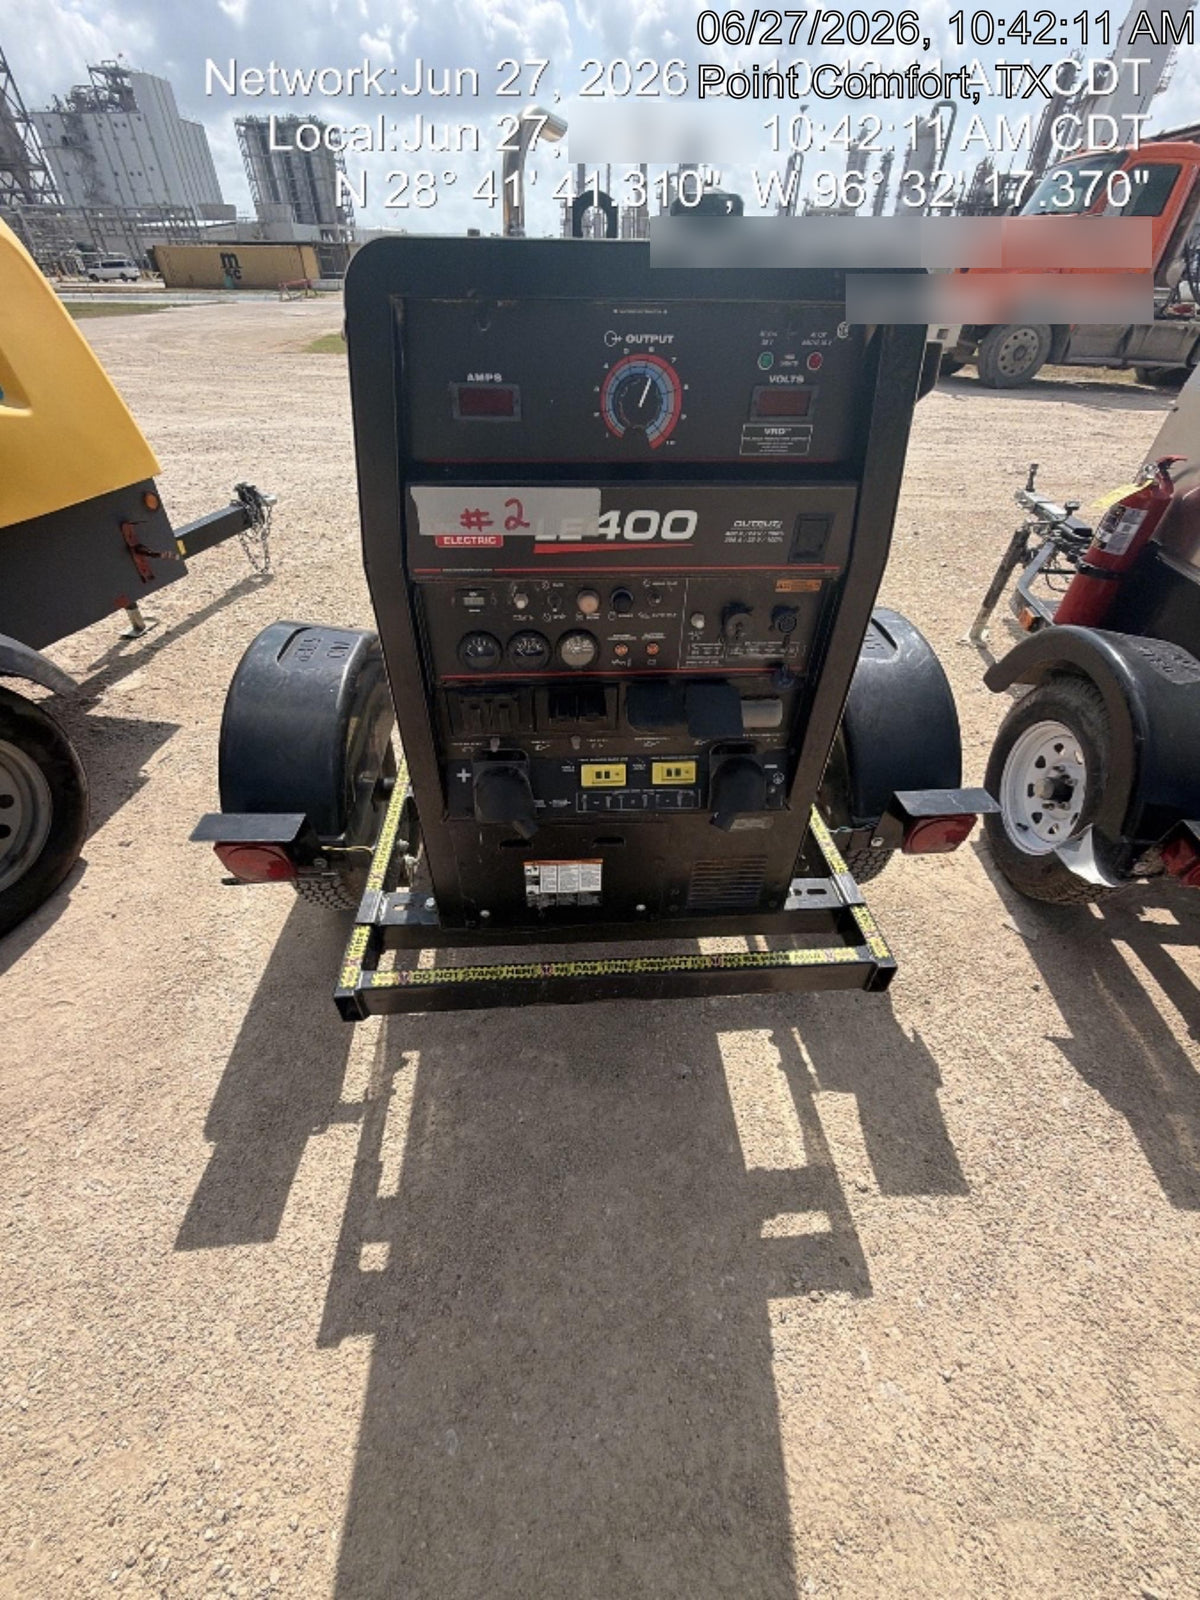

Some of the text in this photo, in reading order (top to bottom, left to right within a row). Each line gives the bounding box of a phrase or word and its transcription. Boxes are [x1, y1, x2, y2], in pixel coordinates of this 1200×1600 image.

[625, 334, 674, 345] OUTPUT
[466, 372, 805, 384] AMPS VOLTS
[443, 536, 497, 546] ELECTRIC
[463, 969, 503, 978] STAND
